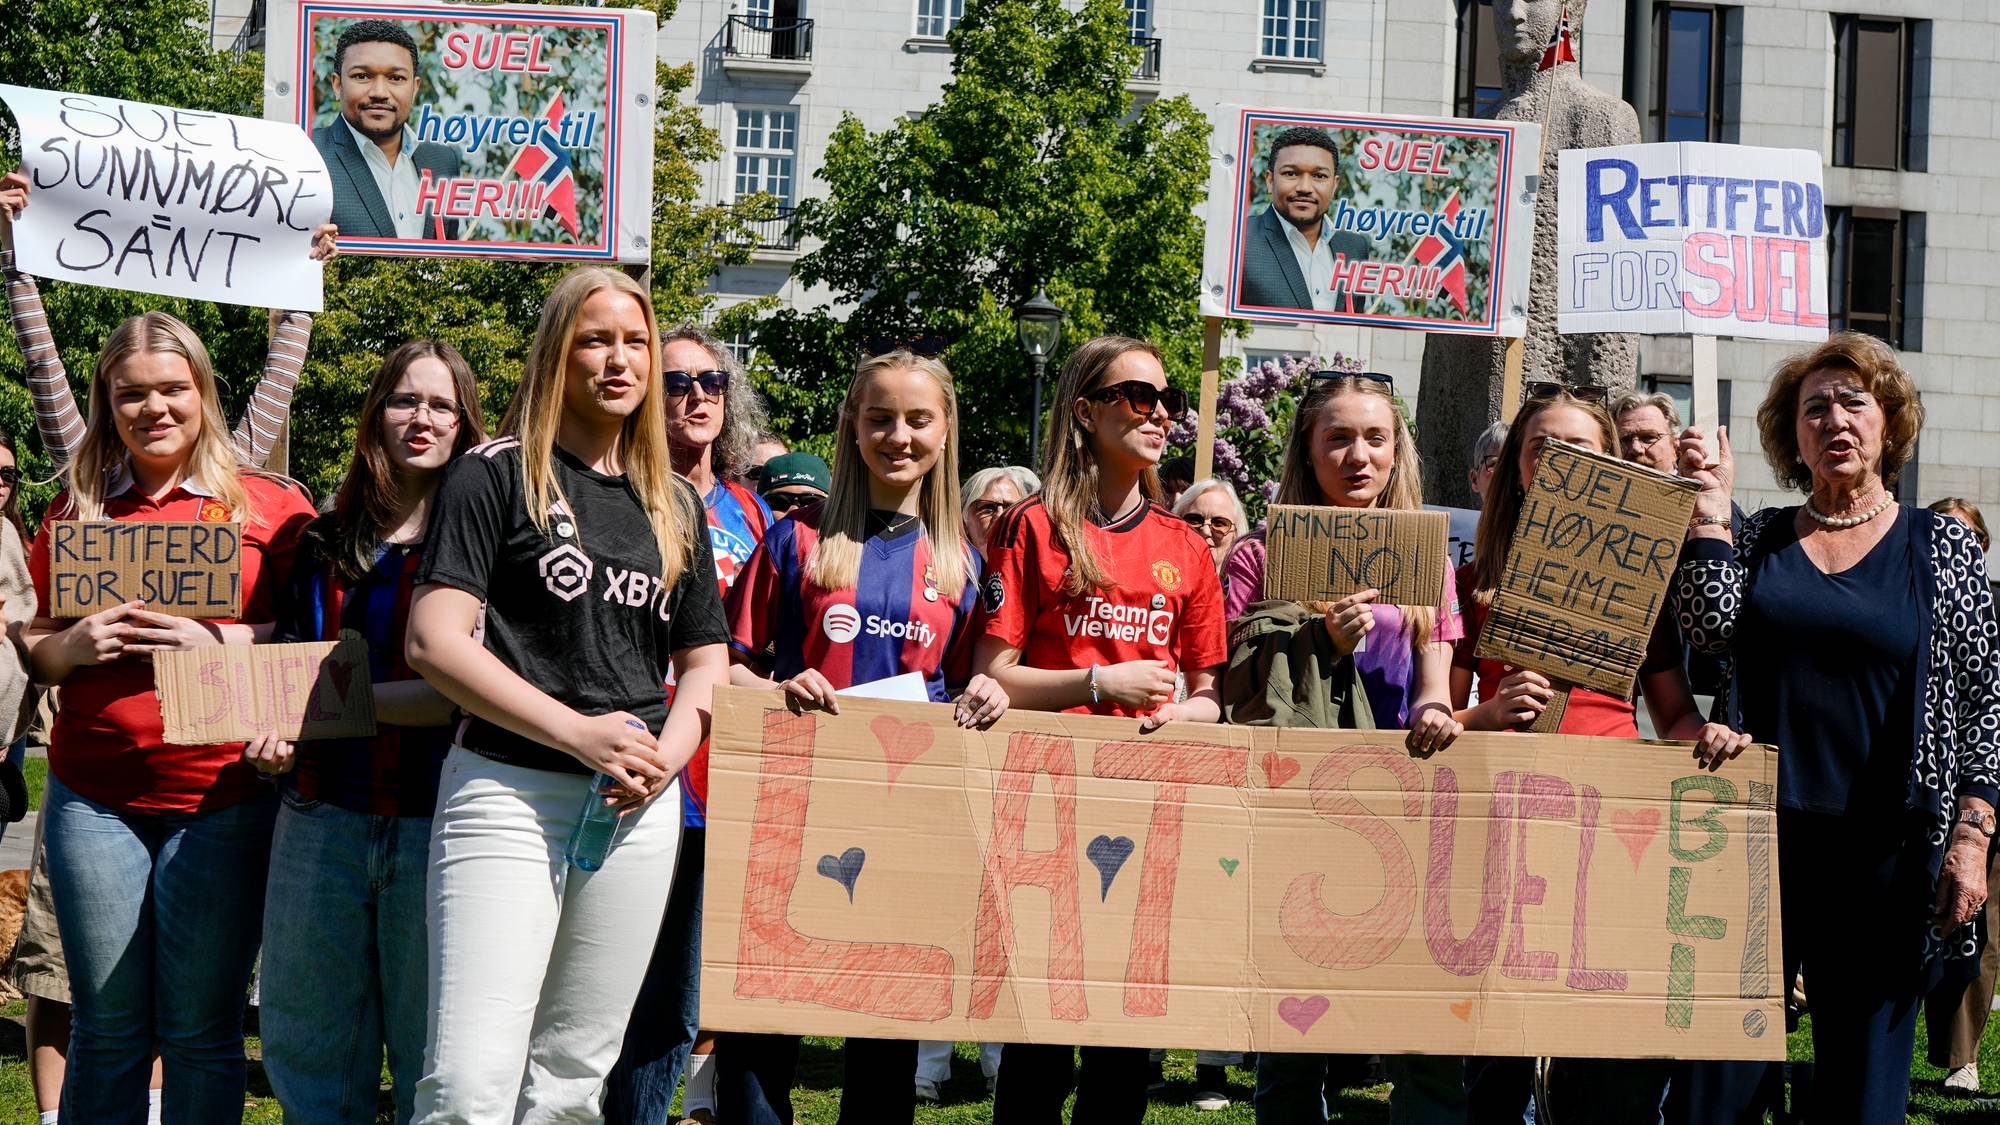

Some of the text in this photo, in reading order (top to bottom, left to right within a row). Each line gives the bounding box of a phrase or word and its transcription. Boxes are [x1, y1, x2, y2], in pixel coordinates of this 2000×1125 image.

[442, 30, 552, 72] SUEL
[60, 97, 285, 161] SUEL
[417, 104, 597, 153] høyrer til
[1359, 138, 1451, 175] SUEL
[415, 177, 546, 219] HER!!!
[1586, 158, 1824, 242] RETTFERD
[1334, 199, 1487, 241] høyrer til
[56, 209, 261, 288] SANT
[1329, 260, 1442, 299] HER!!!
[1573, 232, 1829, 328] FOR SUEL
[1538, 451, 1642, 519] SUEL
[55, 524, 237, 565] RETTFERD
[1269, 511, 1393, 541] AMNESTI
[1523, 501, 1676, 581] HØYRER
[56, 569, 239, 614] FOR SUEL!
[1086, 597, 1147, 625] Team
[865, 615, 937, 647] Spotify
[1064, 614, 1146, 643] Viewer
[198, 655, 343, 732] SUEL
[1279, 743, 1628, 990] SUEL
